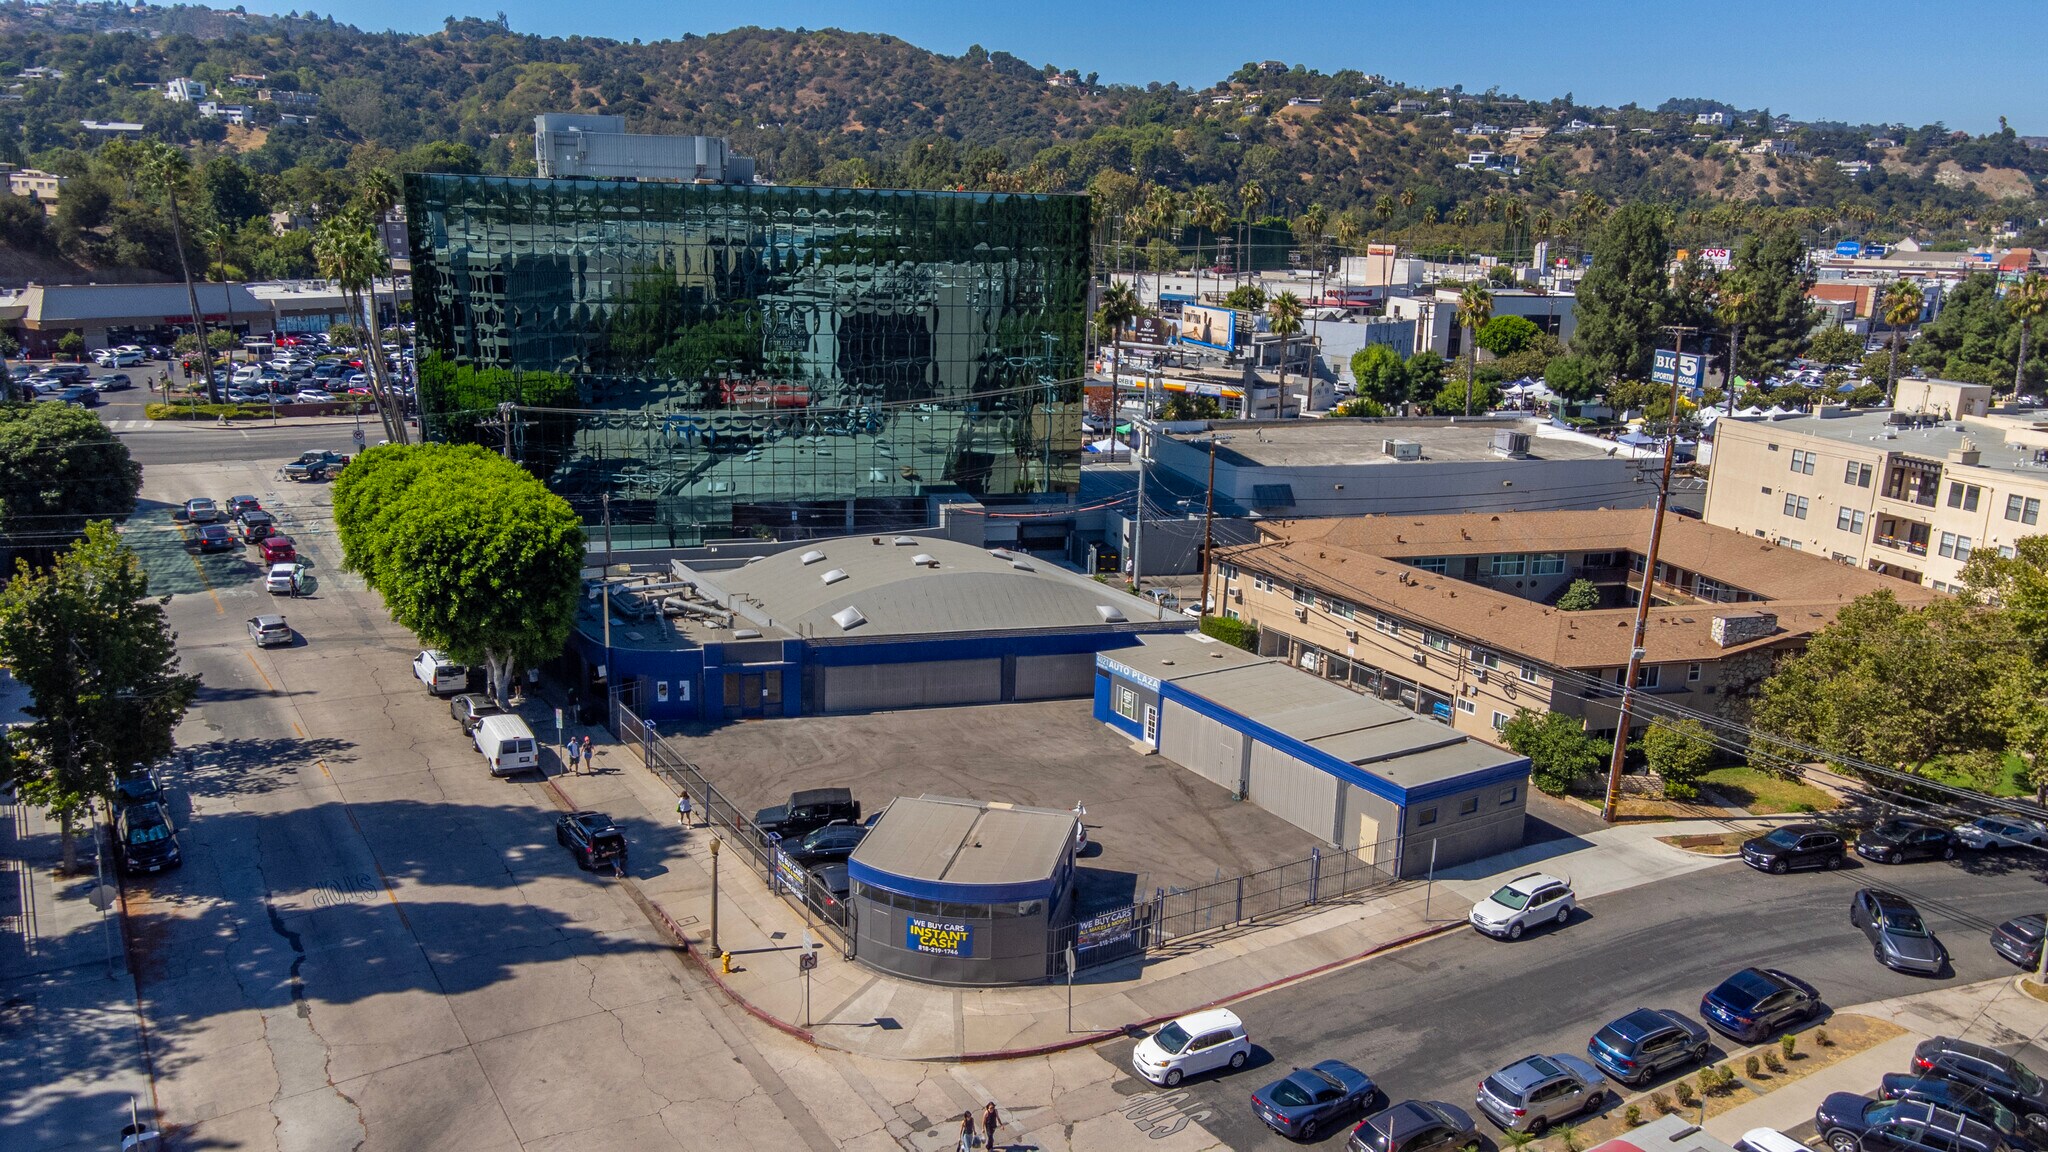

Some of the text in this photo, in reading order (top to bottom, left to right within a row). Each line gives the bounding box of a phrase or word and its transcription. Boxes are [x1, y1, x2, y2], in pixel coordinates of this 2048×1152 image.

[1706, 248, 1726, 257] CVS
[1655, 355, 1697, 377] BIG 5
[1653, 371, 1696, 386] SPORTIN GOODS
[1108, 661, 1130, 676] AUTO
[1132, 670, 1159, 688] PLAZA
[313, 873, 378, 909] STOP
[914, 919, 965, 932] WE BUY CARS
[1080, 909, 1132, 930] WE BUY CARS
[910, 925, 969, 941] INSTANT
[918, 945, 958, 955] 818-219-1746
[920, 936, 958, 949] CASH
